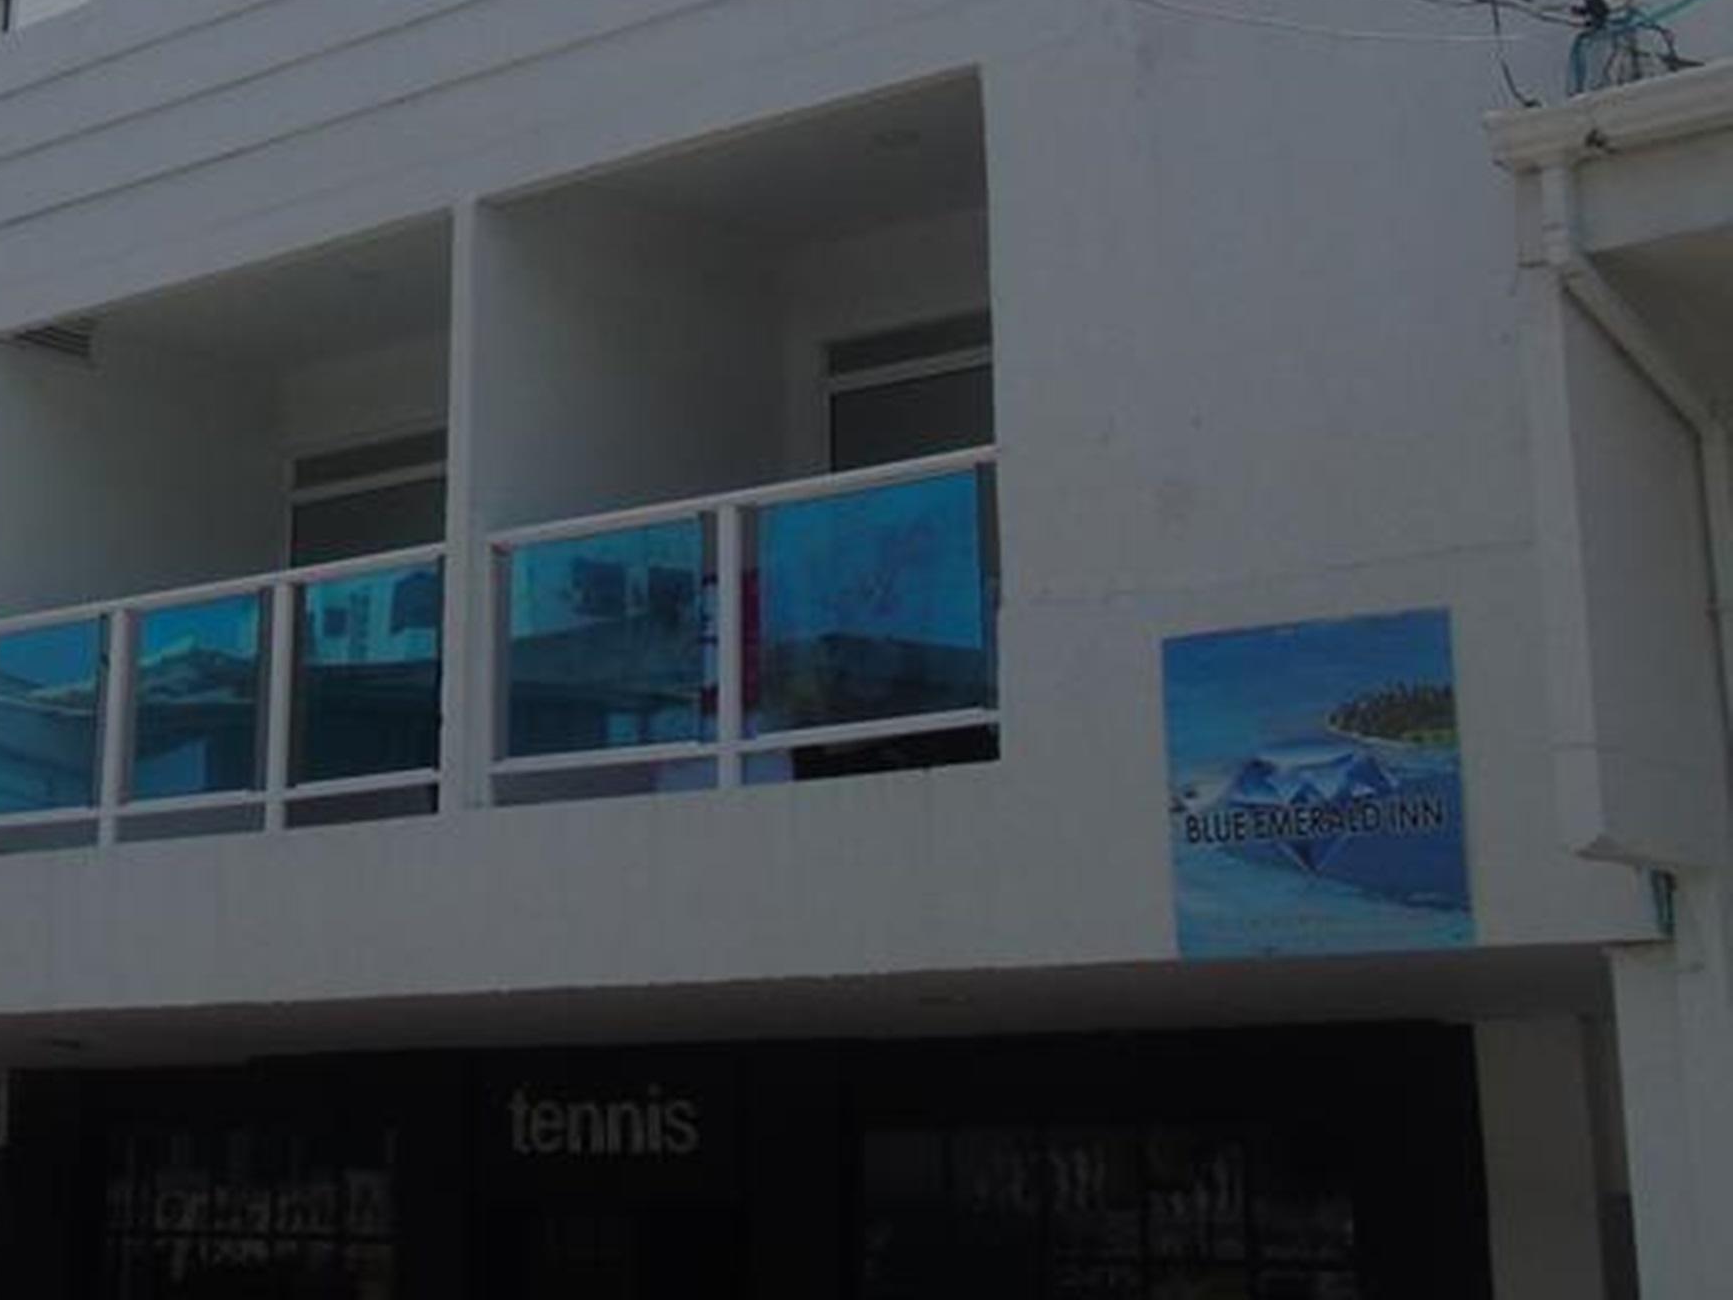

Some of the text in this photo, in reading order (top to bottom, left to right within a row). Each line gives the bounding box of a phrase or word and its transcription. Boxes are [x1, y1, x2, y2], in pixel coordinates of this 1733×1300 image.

[1185, 797, 1443, 844] BLUE EMERALD INN
[505, 1082, 700, 1155] tennis
